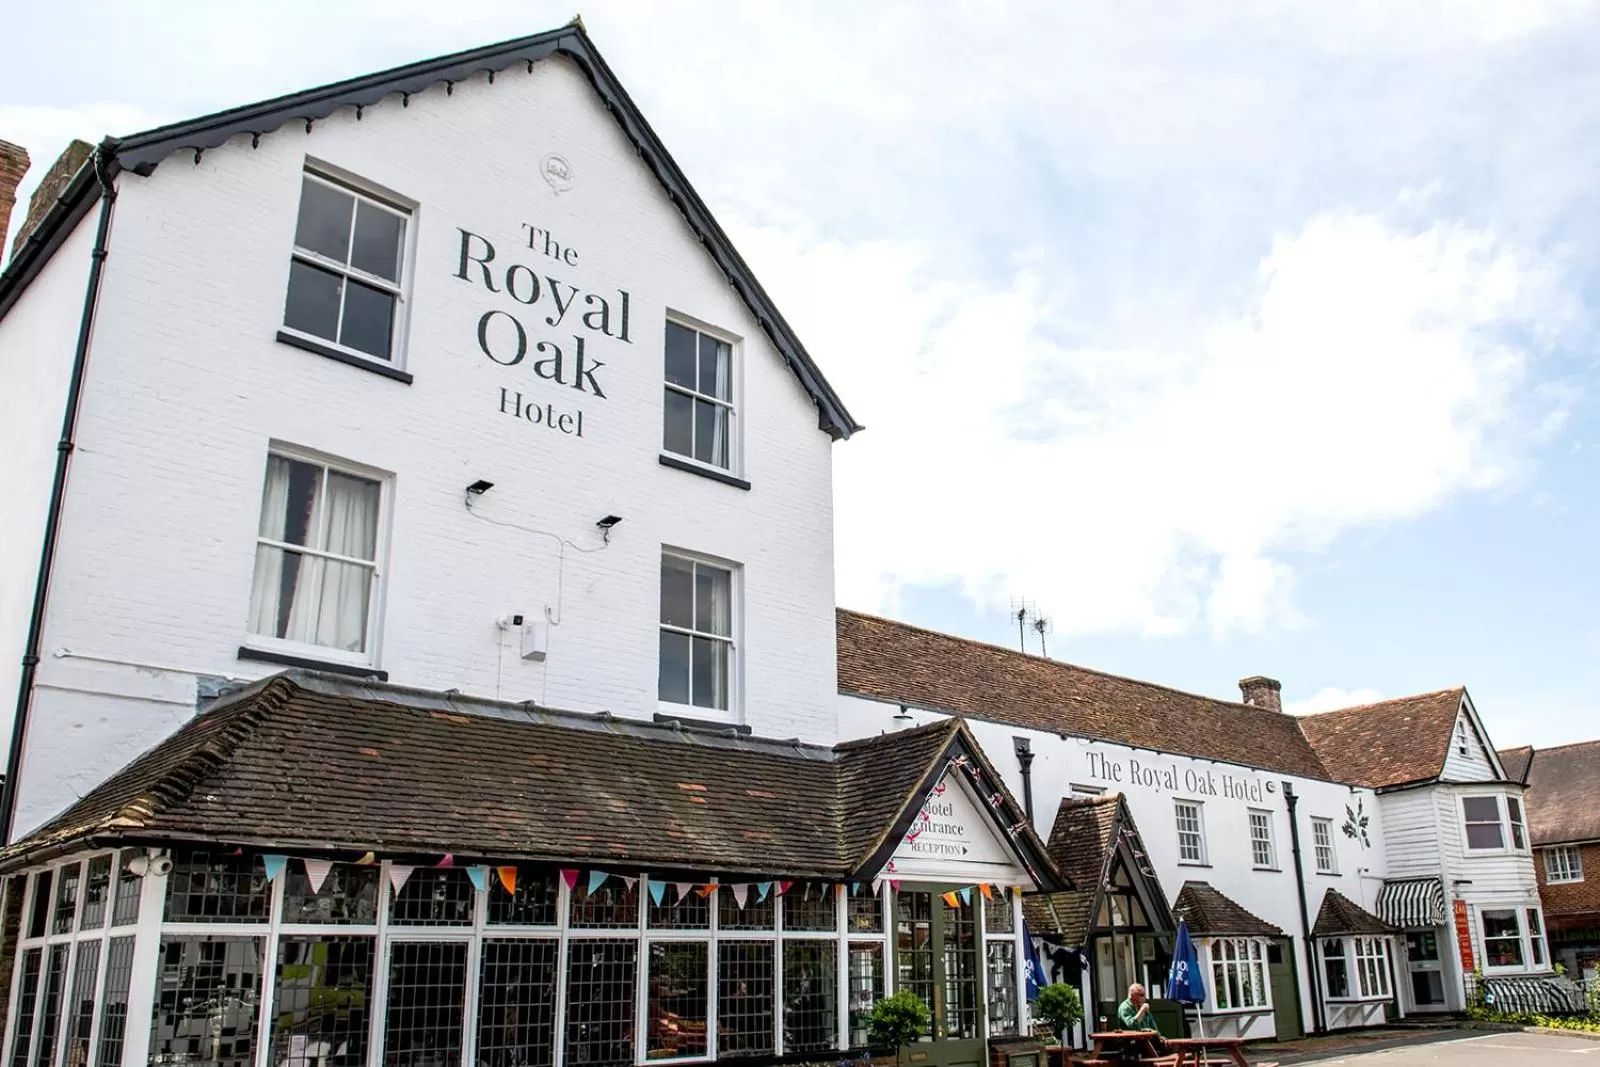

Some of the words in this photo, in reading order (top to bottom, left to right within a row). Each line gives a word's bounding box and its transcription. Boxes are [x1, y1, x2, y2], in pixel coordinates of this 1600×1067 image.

[521, 223, 579, 267] The
[452, 226, 634, 345] Royal
[477, 310, 608, 400] Oak
[498, 387, 583, 438] Hotel
[1086, 751, 1122, 782] The
[1129, 759, 1179, 793] Royal
[1185, 768, 1217, 796] Oak
[1221, 775, 1264, 802] Hotel
[911, 841, 960, 856] RECEPTION
